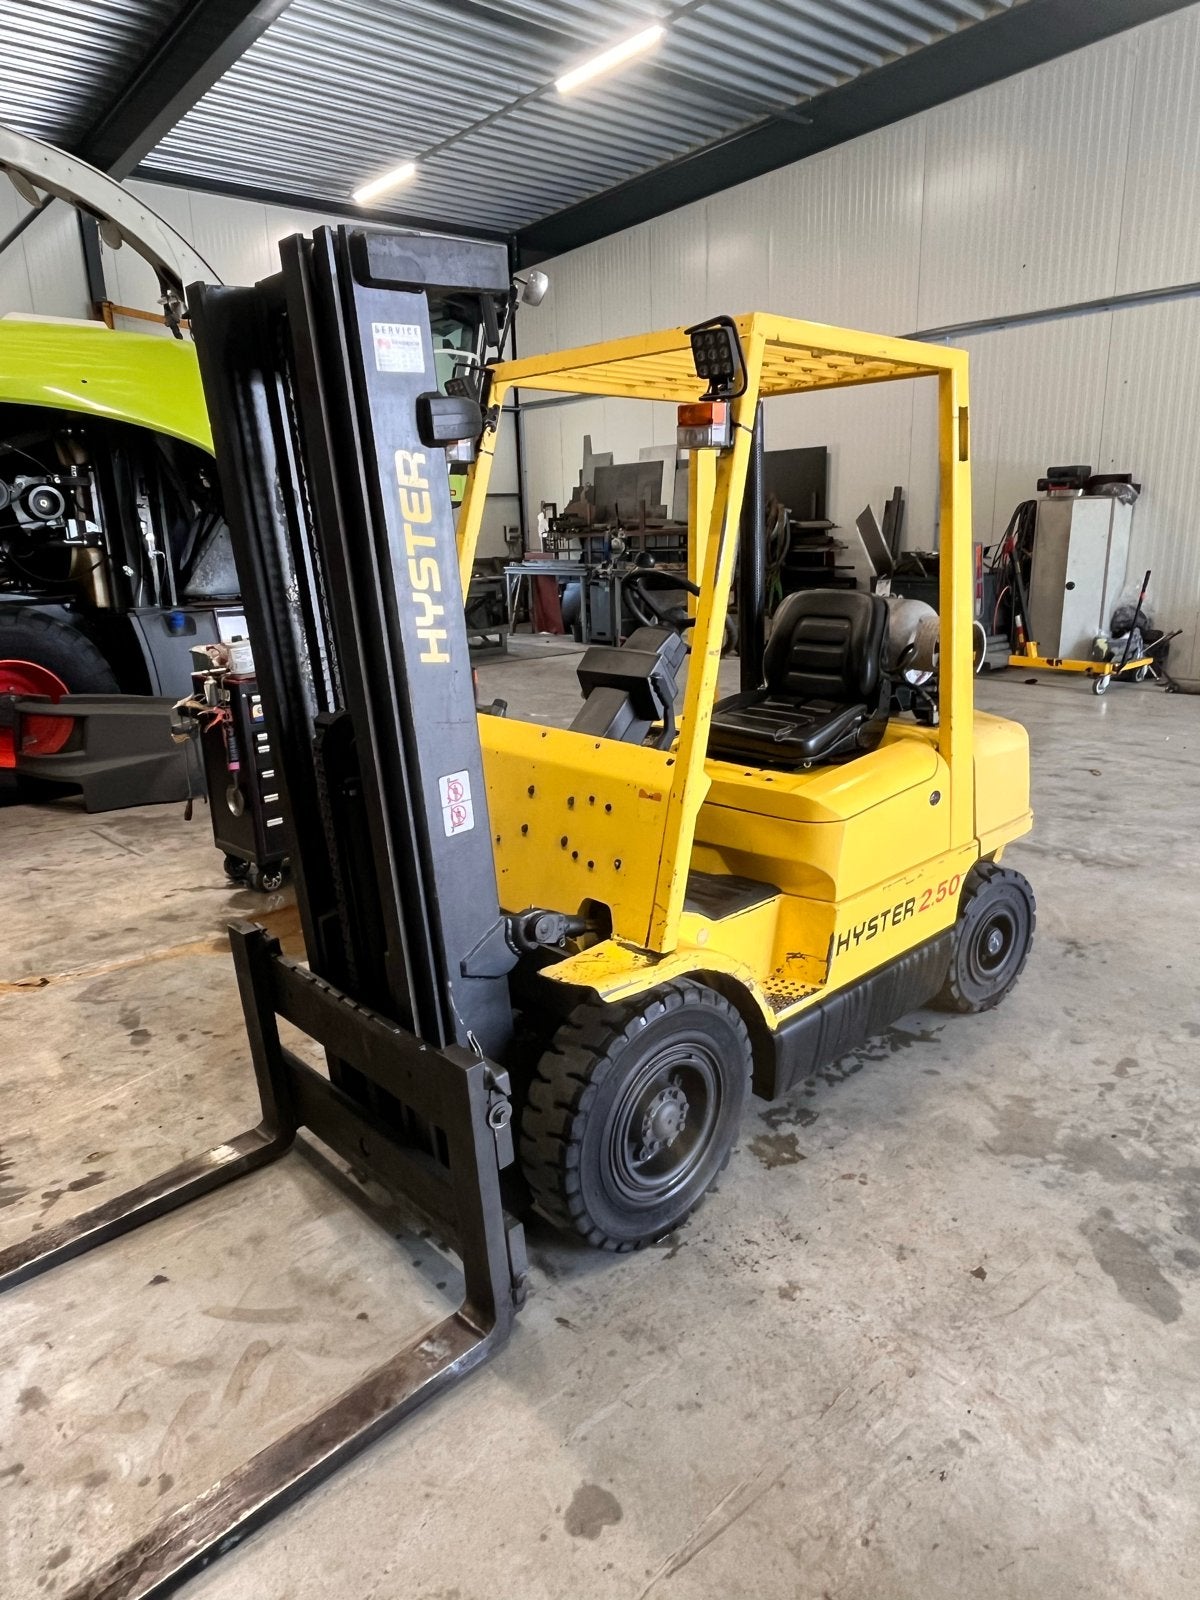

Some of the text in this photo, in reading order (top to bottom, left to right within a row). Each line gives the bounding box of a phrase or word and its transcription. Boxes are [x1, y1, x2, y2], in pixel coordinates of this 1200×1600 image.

[374, 325, 418, 336] SERVICE
[395, 450, 450, 663] HYSTER
[836, 874, 960, 956] HYSTER 2.50
